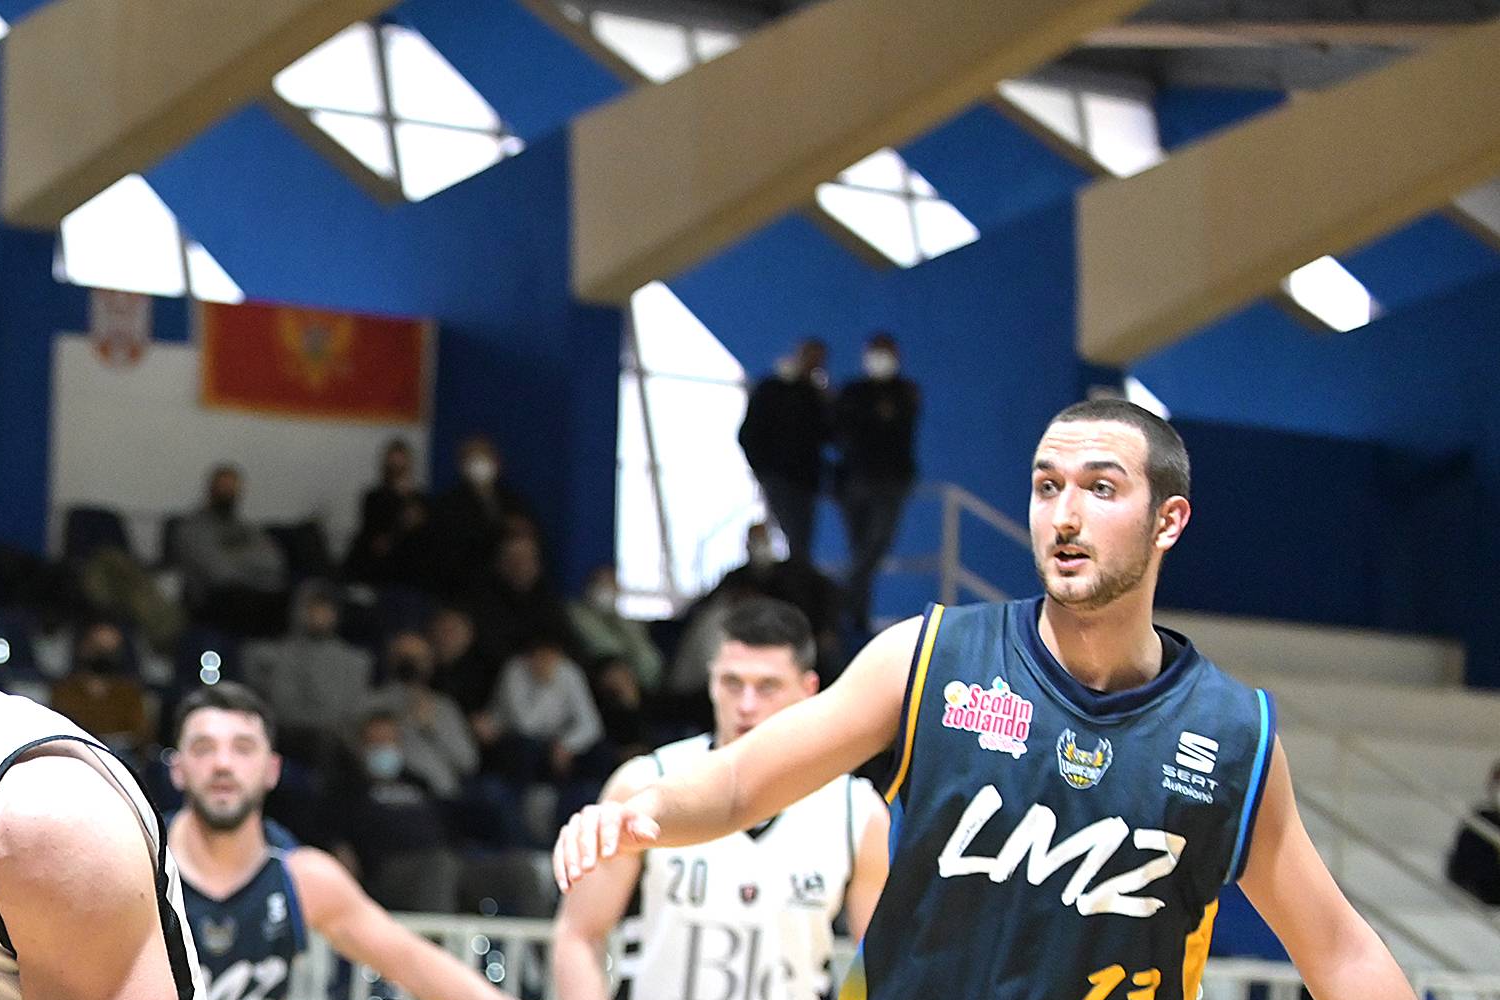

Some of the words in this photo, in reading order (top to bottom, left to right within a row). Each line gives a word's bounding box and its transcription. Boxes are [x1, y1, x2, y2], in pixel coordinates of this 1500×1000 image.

[968, 687, 1031, 720] Scodin
[945, 706, 1028, 740] zoolando
[1162, 764, 1219, 791] SEAT
[938, 784, 1188, 918] LMZ
[666, 855, 709, 908] 20
